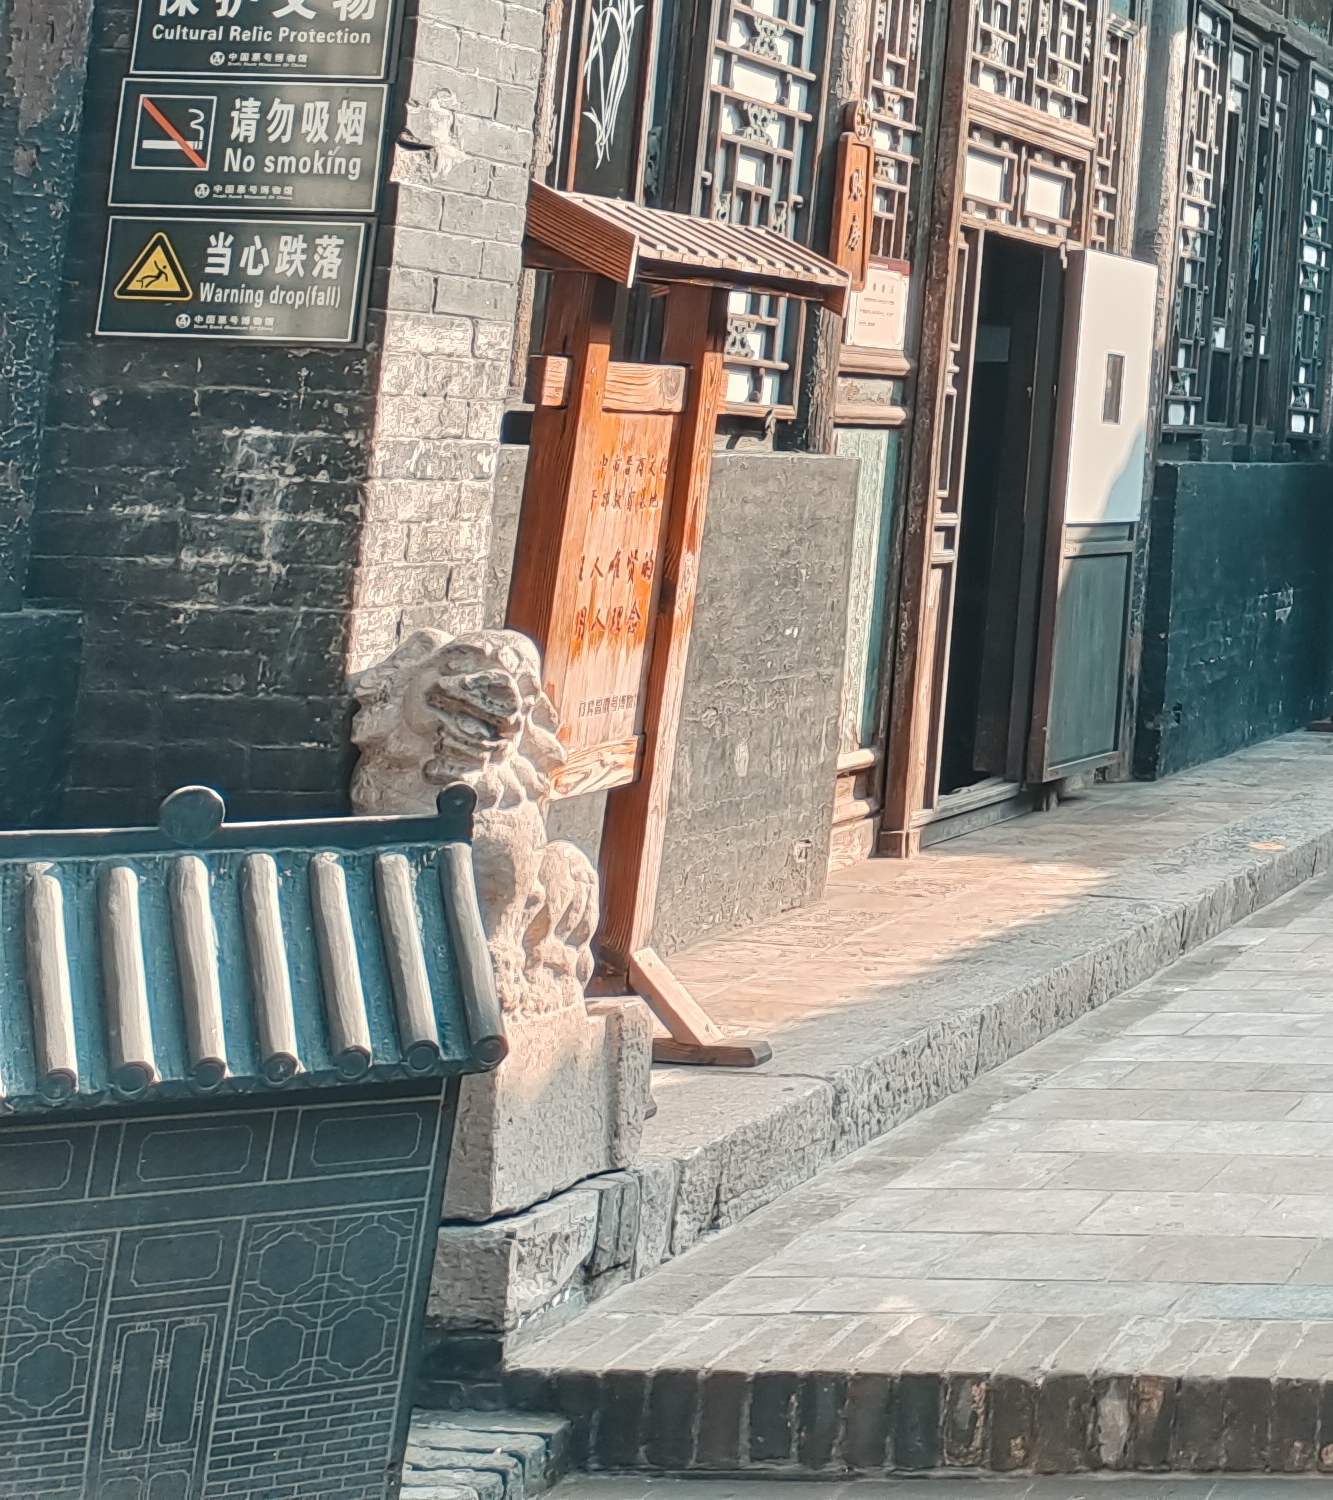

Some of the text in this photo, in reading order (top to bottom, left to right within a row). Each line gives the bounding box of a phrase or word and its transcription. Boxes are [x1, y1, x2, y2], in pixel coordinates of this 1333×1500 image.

[152, 23, 372, 45] Cultural Relic Protection
[230, 97, 367, 147] 请勿吸烟
[224, 148, 362, 181] No smoking
[204, 231, 344, 280] 当心跌落
[200, 282, 342, 309] Warning drop(fall)
